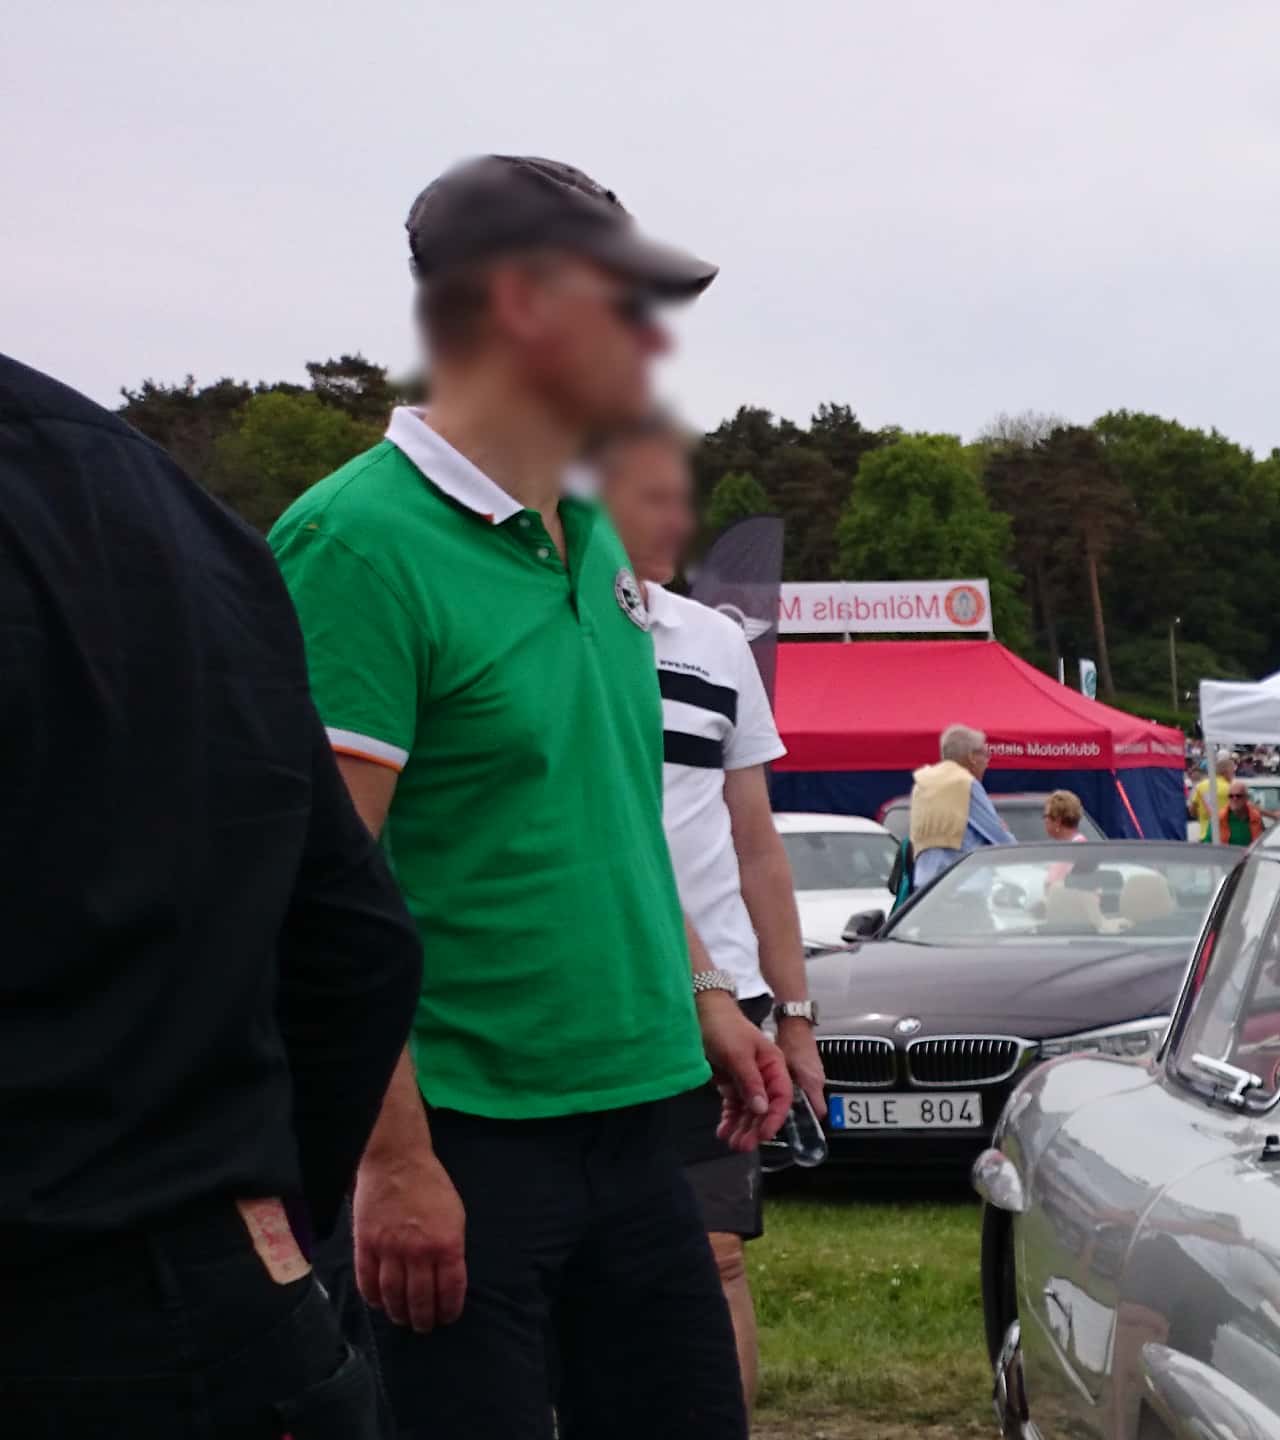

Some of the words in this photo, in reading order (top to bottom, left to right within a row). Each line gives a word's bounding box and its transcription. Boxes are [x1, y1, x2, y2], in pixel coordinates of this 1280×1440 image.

[984, 743, 1024, 756] lndals
[1026, 742, 1101, 757] Motorklubb
[848, 1100, 899, 1124] SLE
[920, 1099, 973, 1124] 804
